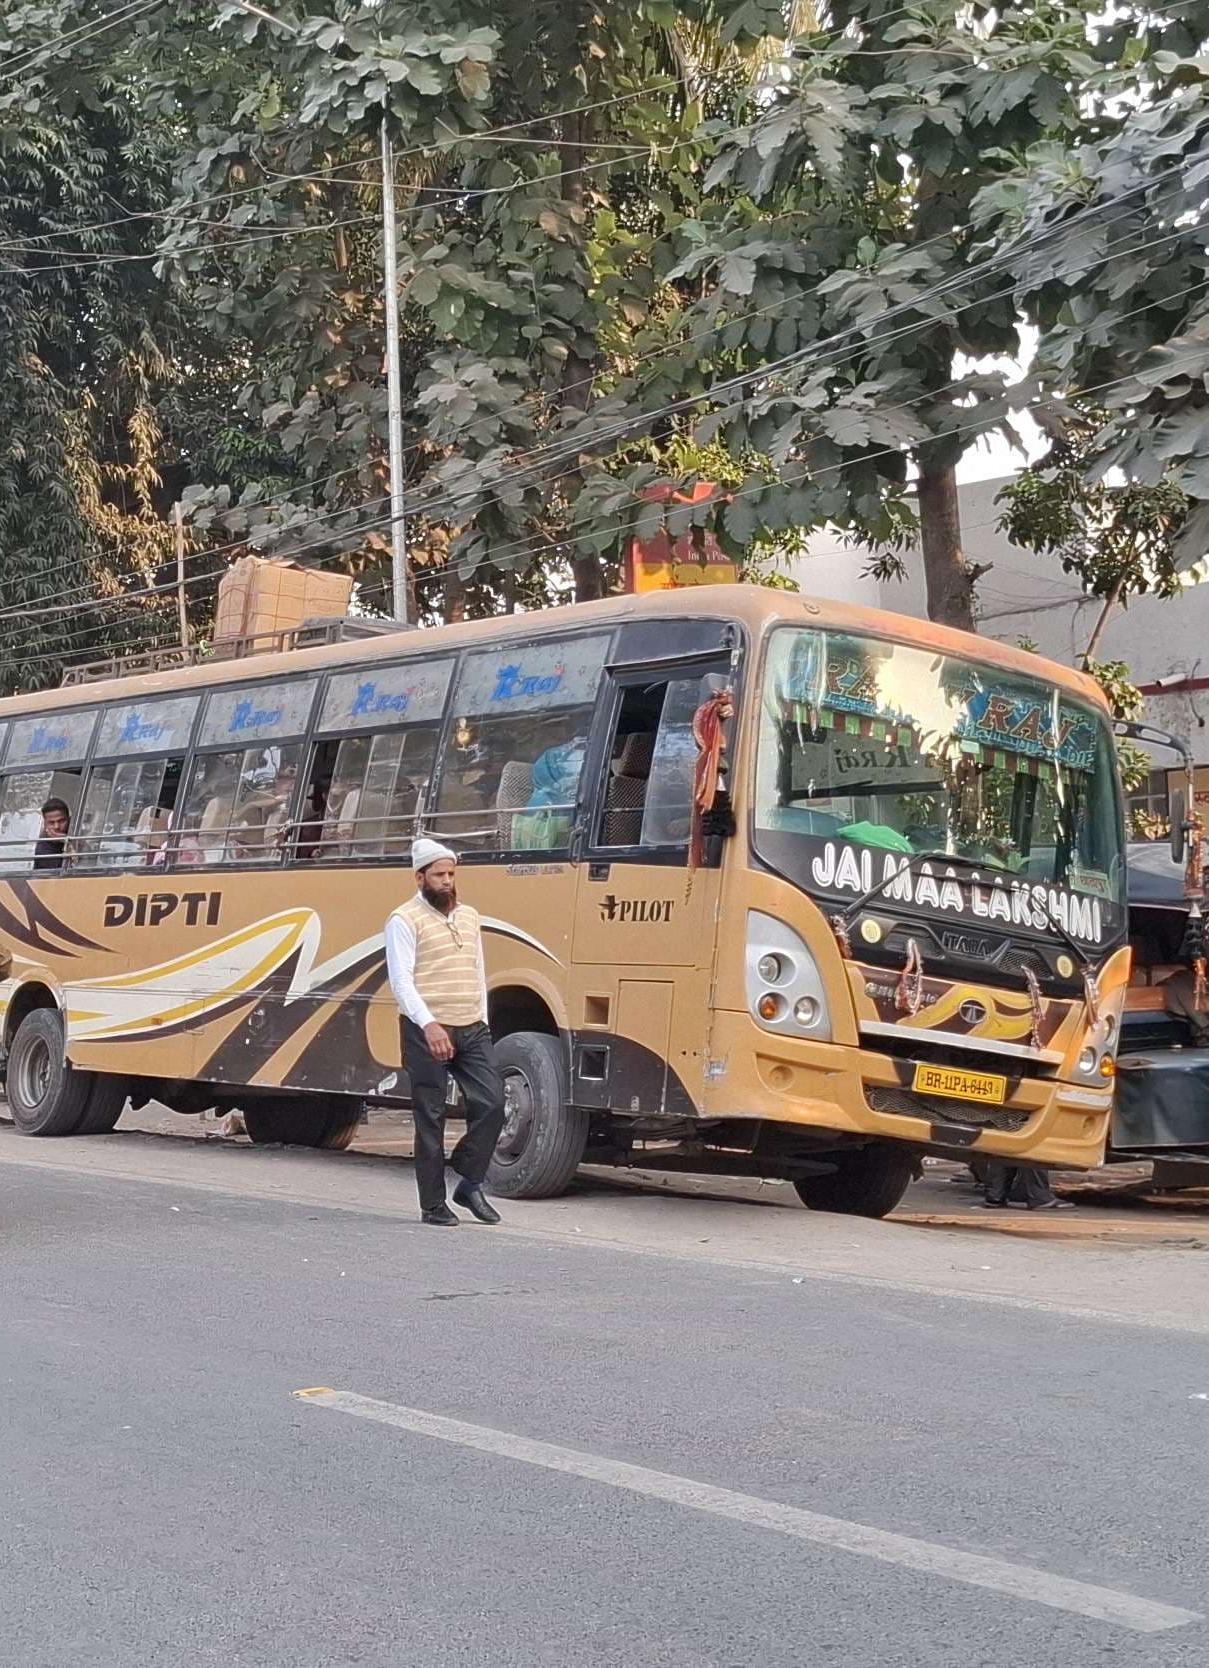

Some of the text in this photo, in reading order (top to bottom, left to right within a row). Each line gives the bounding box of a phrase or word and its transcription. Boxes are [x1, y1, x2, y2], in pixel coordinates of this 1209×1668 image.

[977, 694, 1077, 750] RAJ
[103, 891, 222, 927] DIPTI
[618, 900, 675, 922] PILOT
[812, 843, 1102, 943] JAI MAA LAKSHMI
[946, 932, 991, 957] TATA
